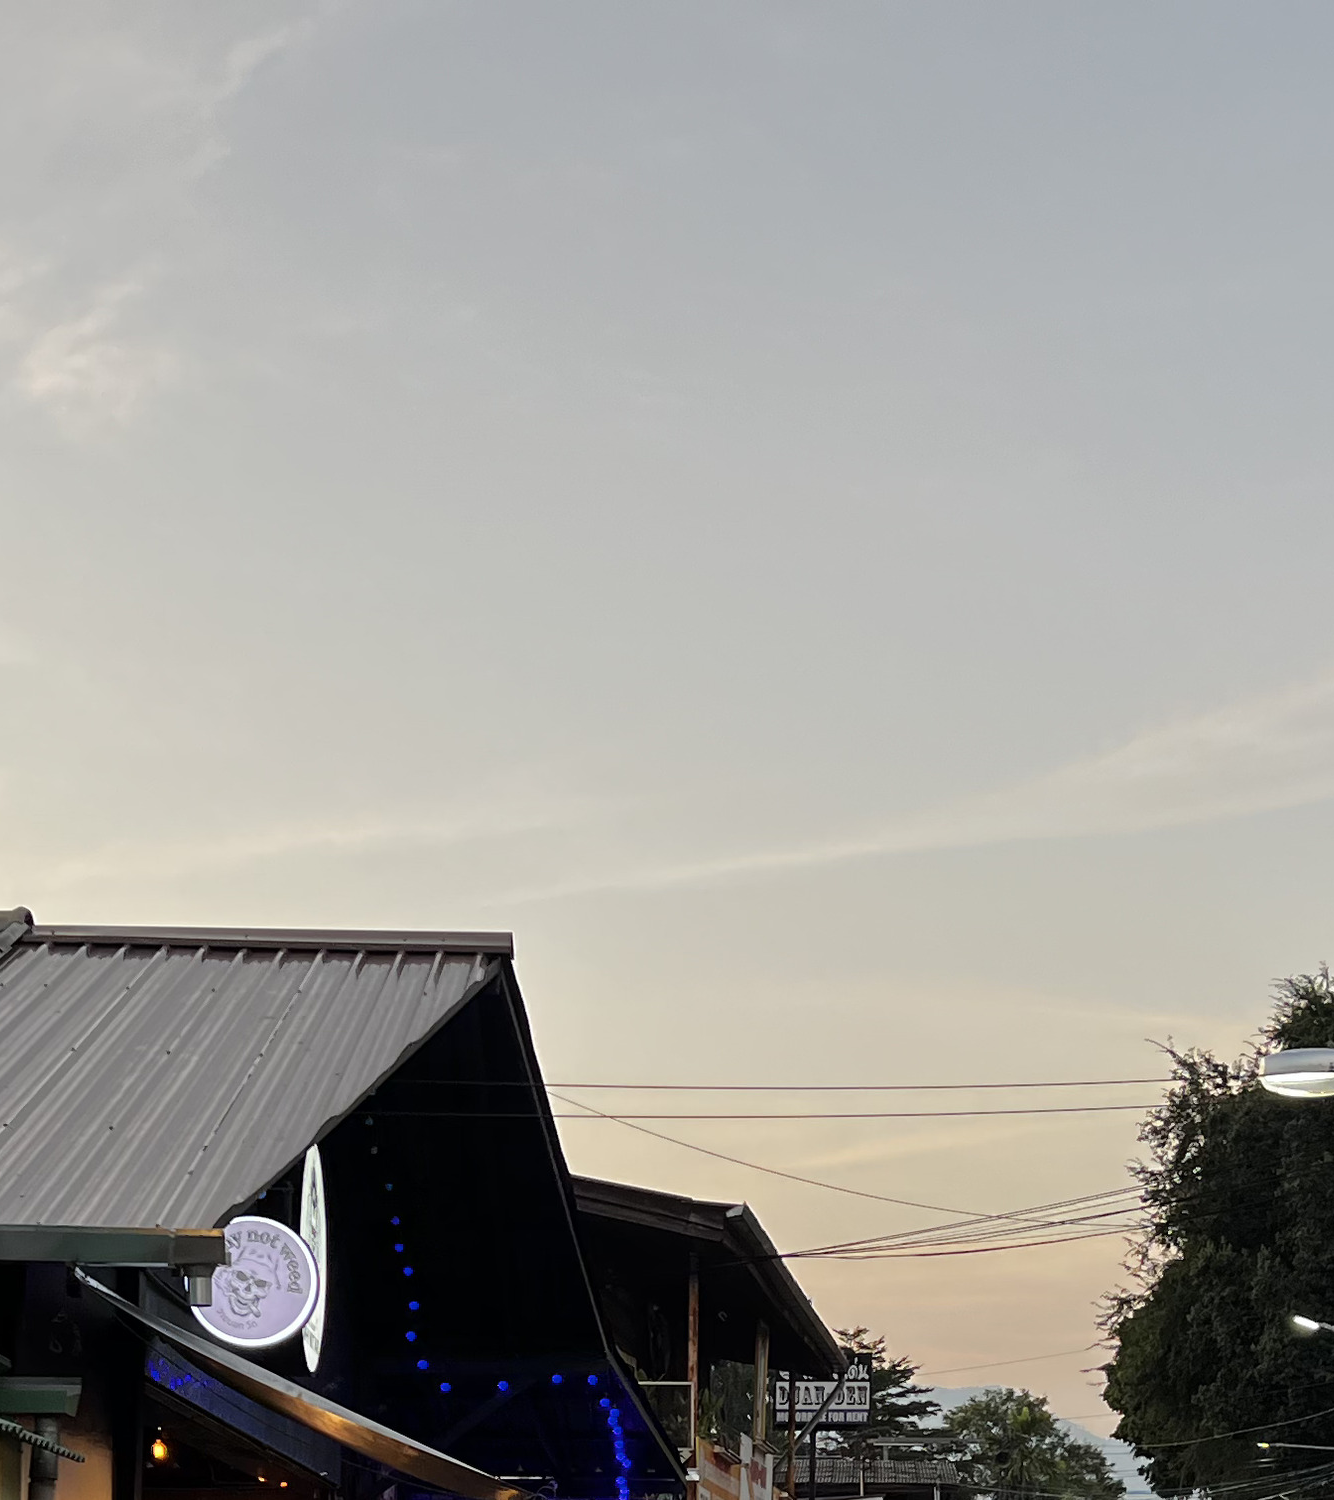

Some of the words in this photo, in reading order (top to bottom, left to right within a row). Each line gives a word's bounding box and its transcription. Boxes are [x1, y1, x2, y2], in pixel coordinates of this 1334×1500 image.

[246, 1228, 281, 1248] not
[279, 1242, 304, 1295] weed
[828, 1411, 845, 1423] FOR
